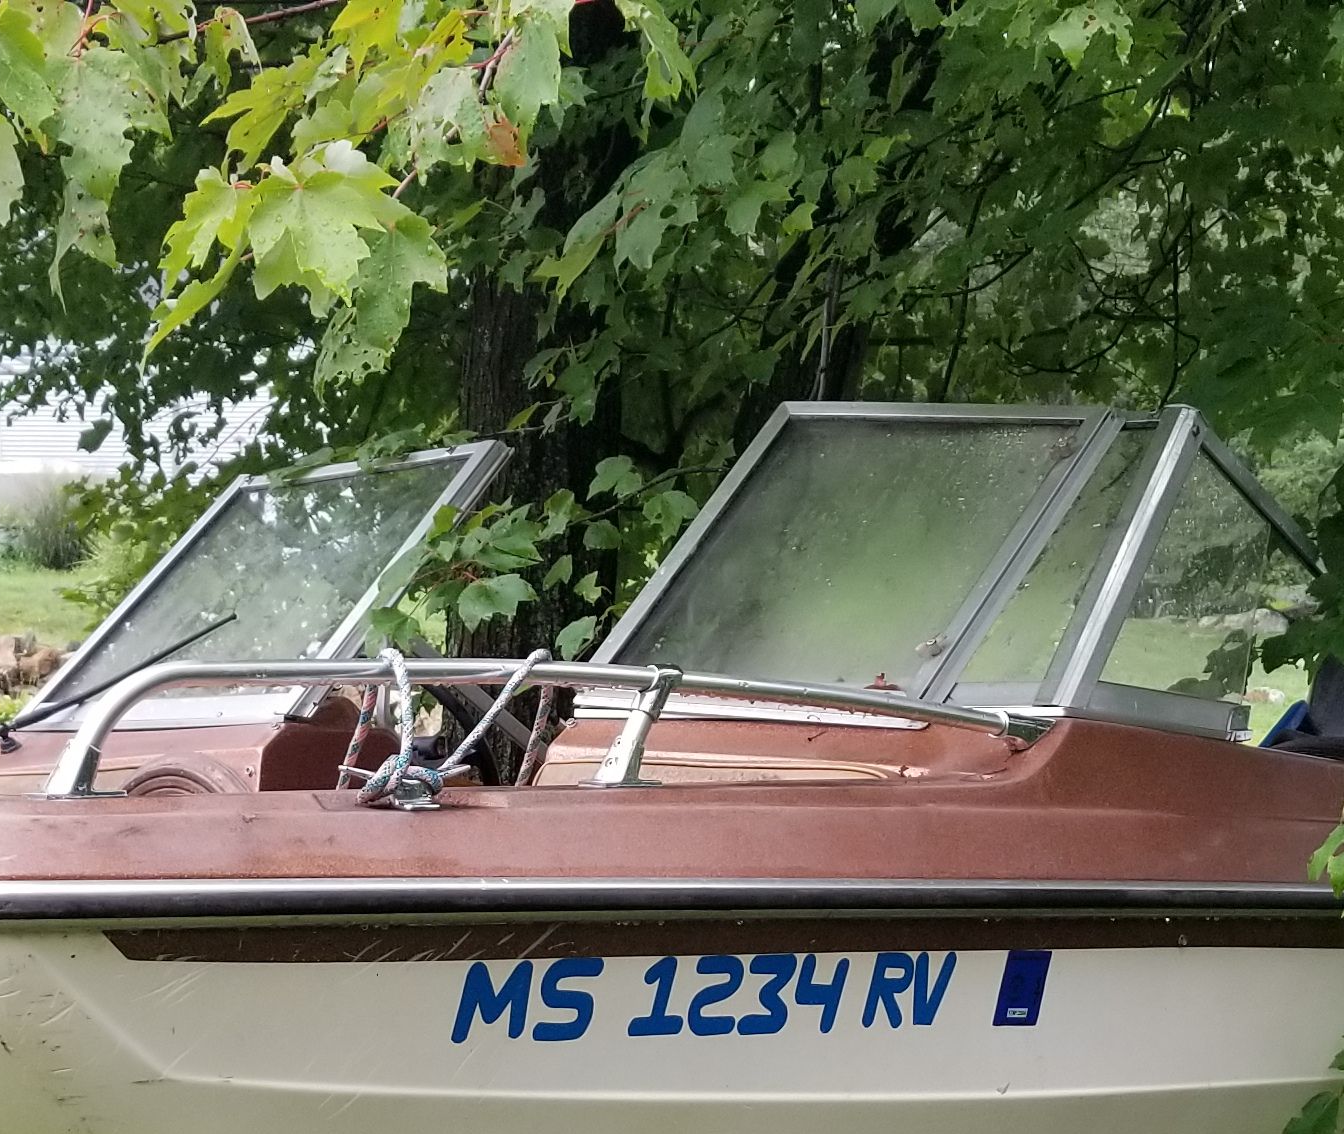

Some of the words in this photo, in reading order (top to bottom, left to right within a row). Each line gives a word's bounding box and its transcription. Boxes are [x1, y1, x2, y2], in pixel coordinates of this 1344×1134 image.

[451, 957, 604, 1043] MS
[628, 953, 850, 1037] 1234
[862, 951, 957, 1029] RV
